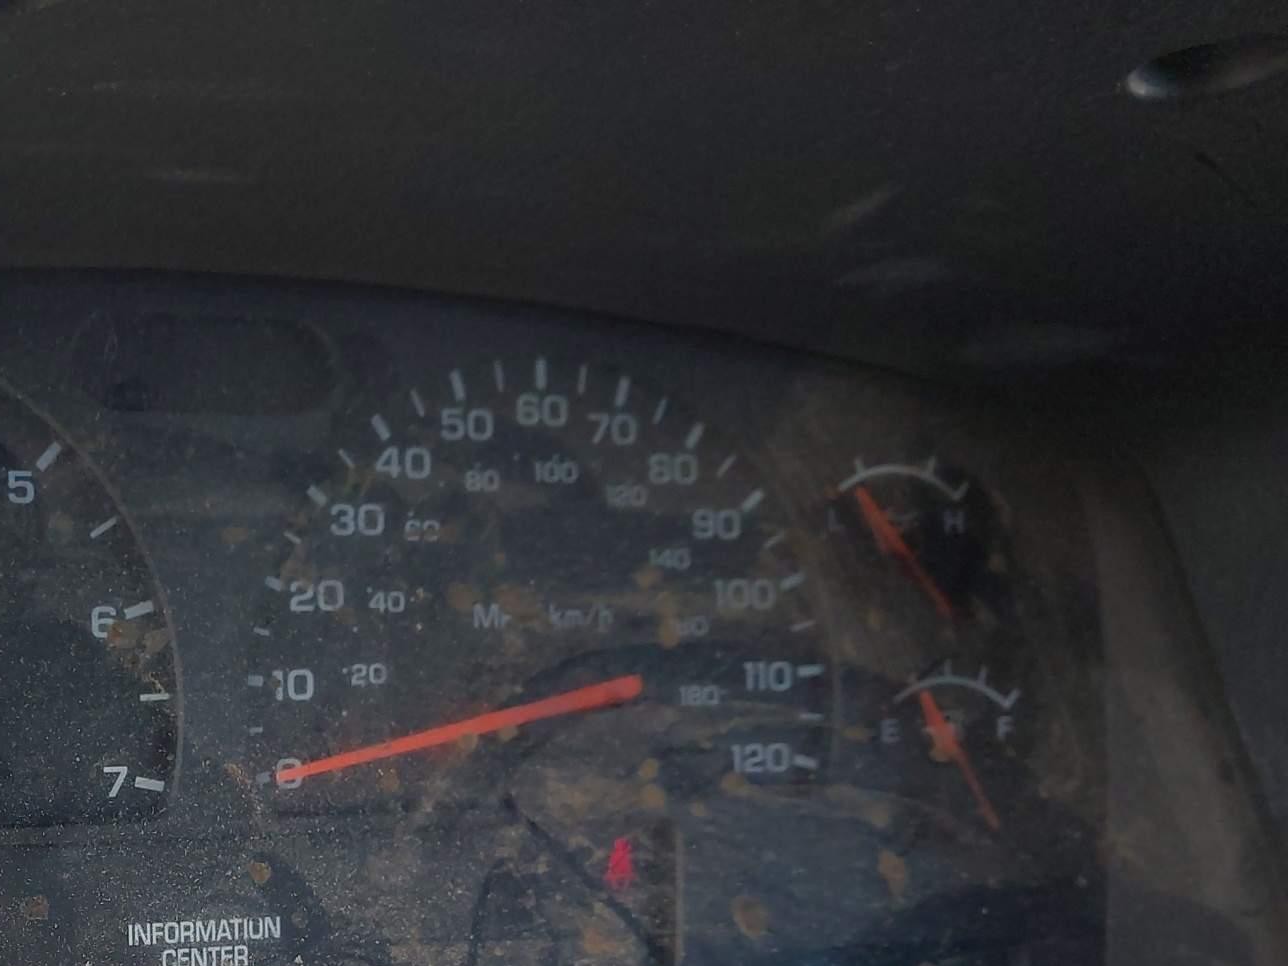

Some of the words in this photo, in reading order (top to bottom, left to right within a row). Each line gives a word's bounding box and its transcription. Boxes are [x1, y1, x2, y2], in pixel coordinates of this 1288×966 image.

[440, 408, 494, 441] 50
[515, 393, 568, 427] 60
[587, 412, 638, 445] 70
[375, 446, 432, 480] 40
[535, 460, 579, 484] 100
[648, 452, 699, 486] 80
[7, 470, 36, 504] 5
[464, 468, 500, 492] 80
[330, 503, 385, 536] 30
[404, 519, 441, 542] 60
[692, 508, 742, 541] 90
[943, 509, 965, 534] H
[289, 579, 345, 613] 20
[368, 590, 406, 613] 40
[713, 578, 777, 610] 100
[91, 606, 118, 639] 6
[272, 668, 315, 701] 10
[350, 663, 388, 688] 20
[743, 660, 793, 692] 110
[996, 715, 1014, 740] F
[730, 742, 792, 774] 120
[103, 766, 128, 797] 7
[128, 916, 281, 946] INFORMATION
